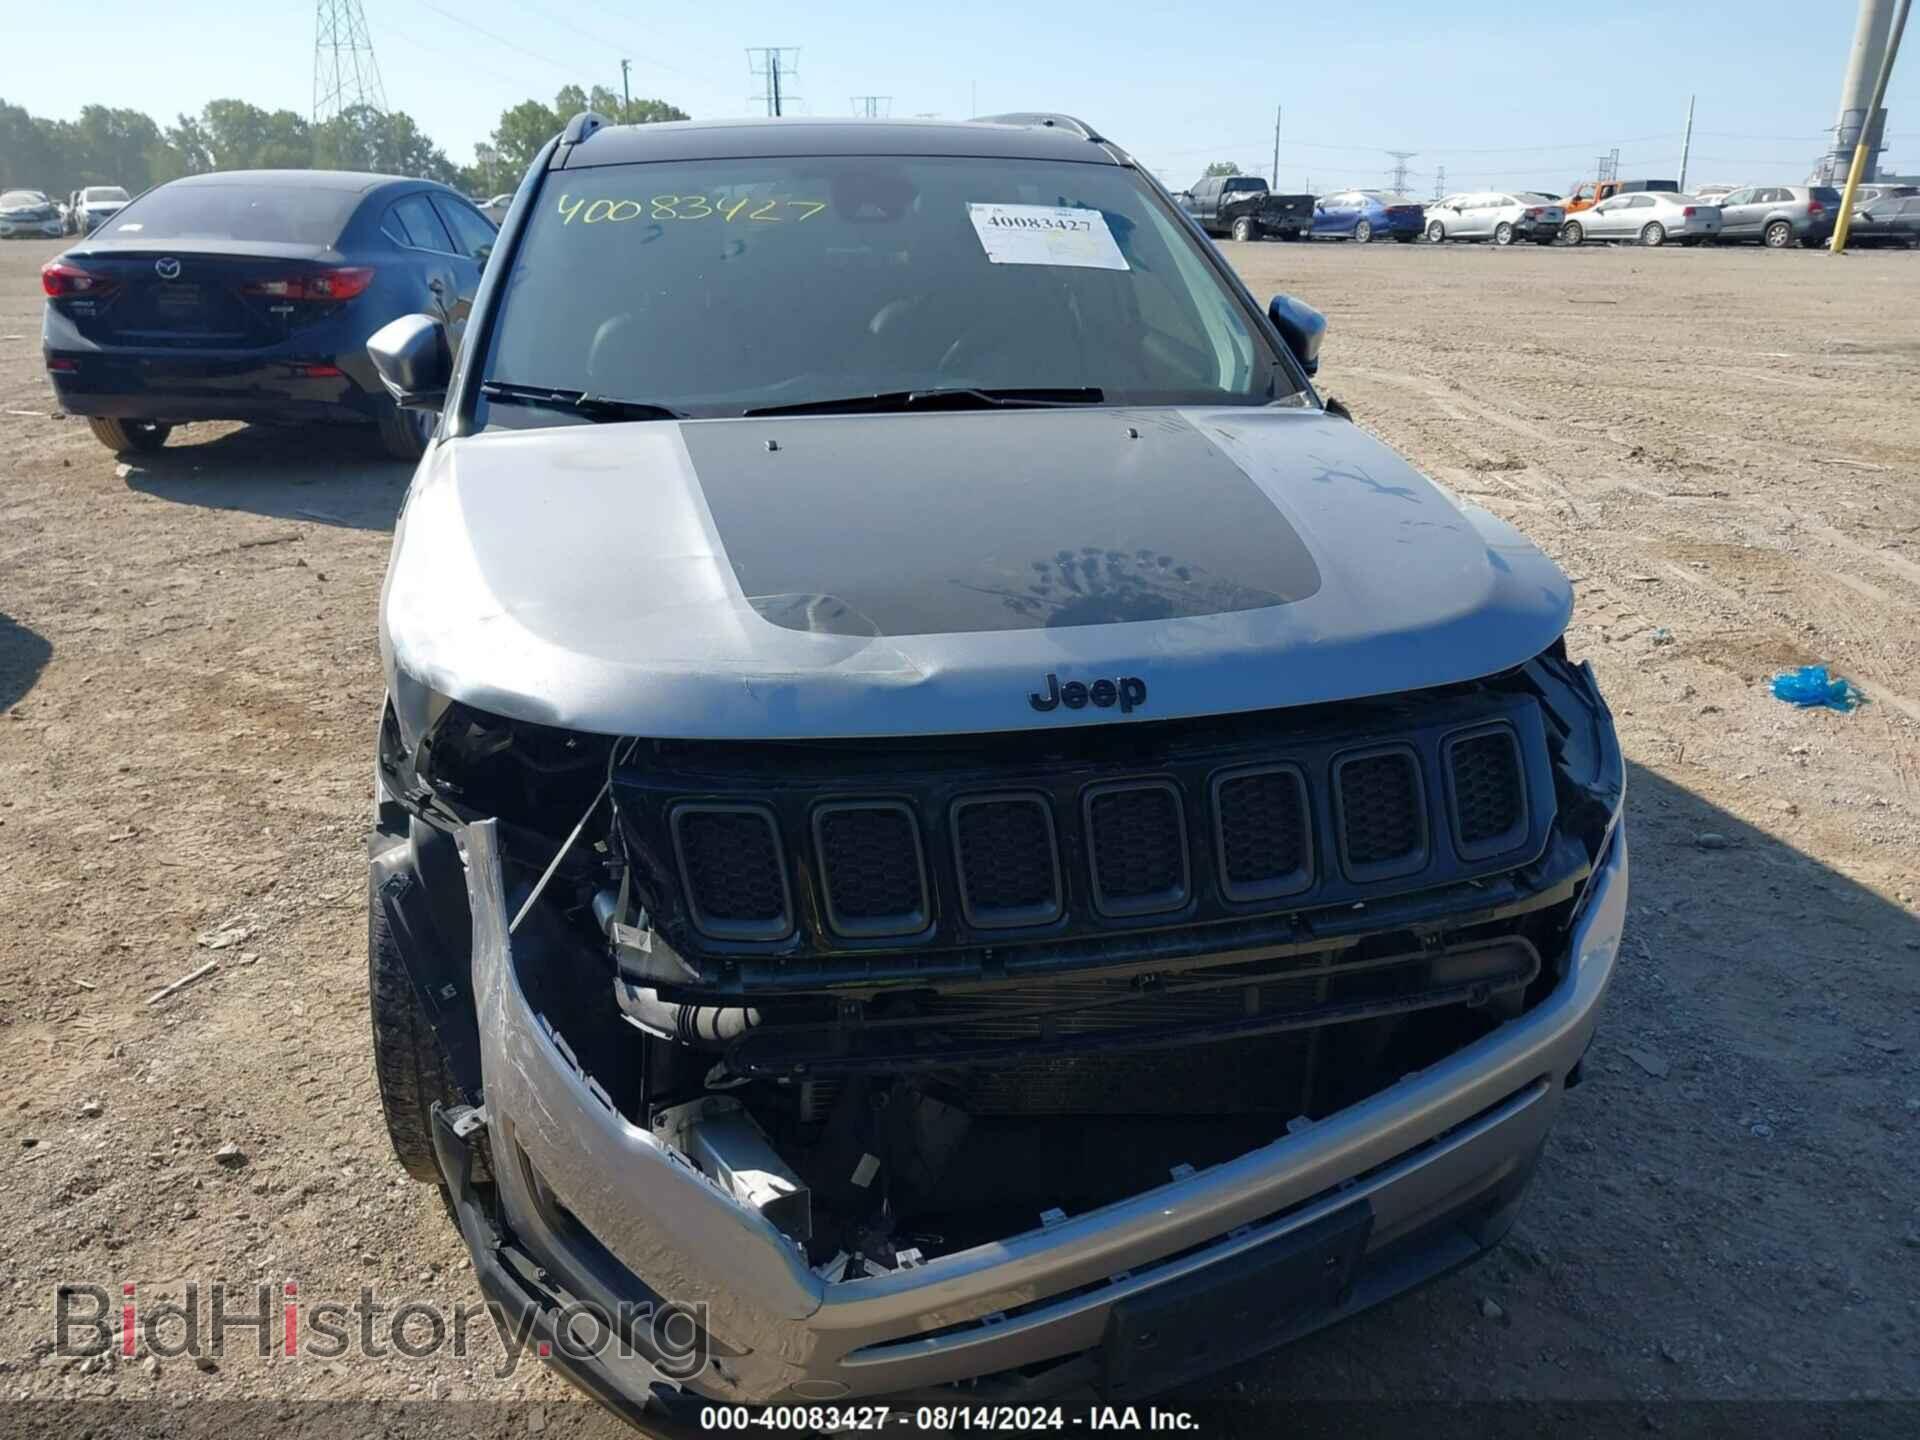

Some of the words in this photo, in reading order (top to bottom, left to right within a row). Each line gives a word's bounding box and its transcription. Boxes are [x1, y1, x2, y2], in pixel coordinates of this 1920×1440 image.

[557, 194, 825, 224] 40083427
[986, 214, 1091, 232] 40083427
[1029, 673, 1147, 713] Jeep
